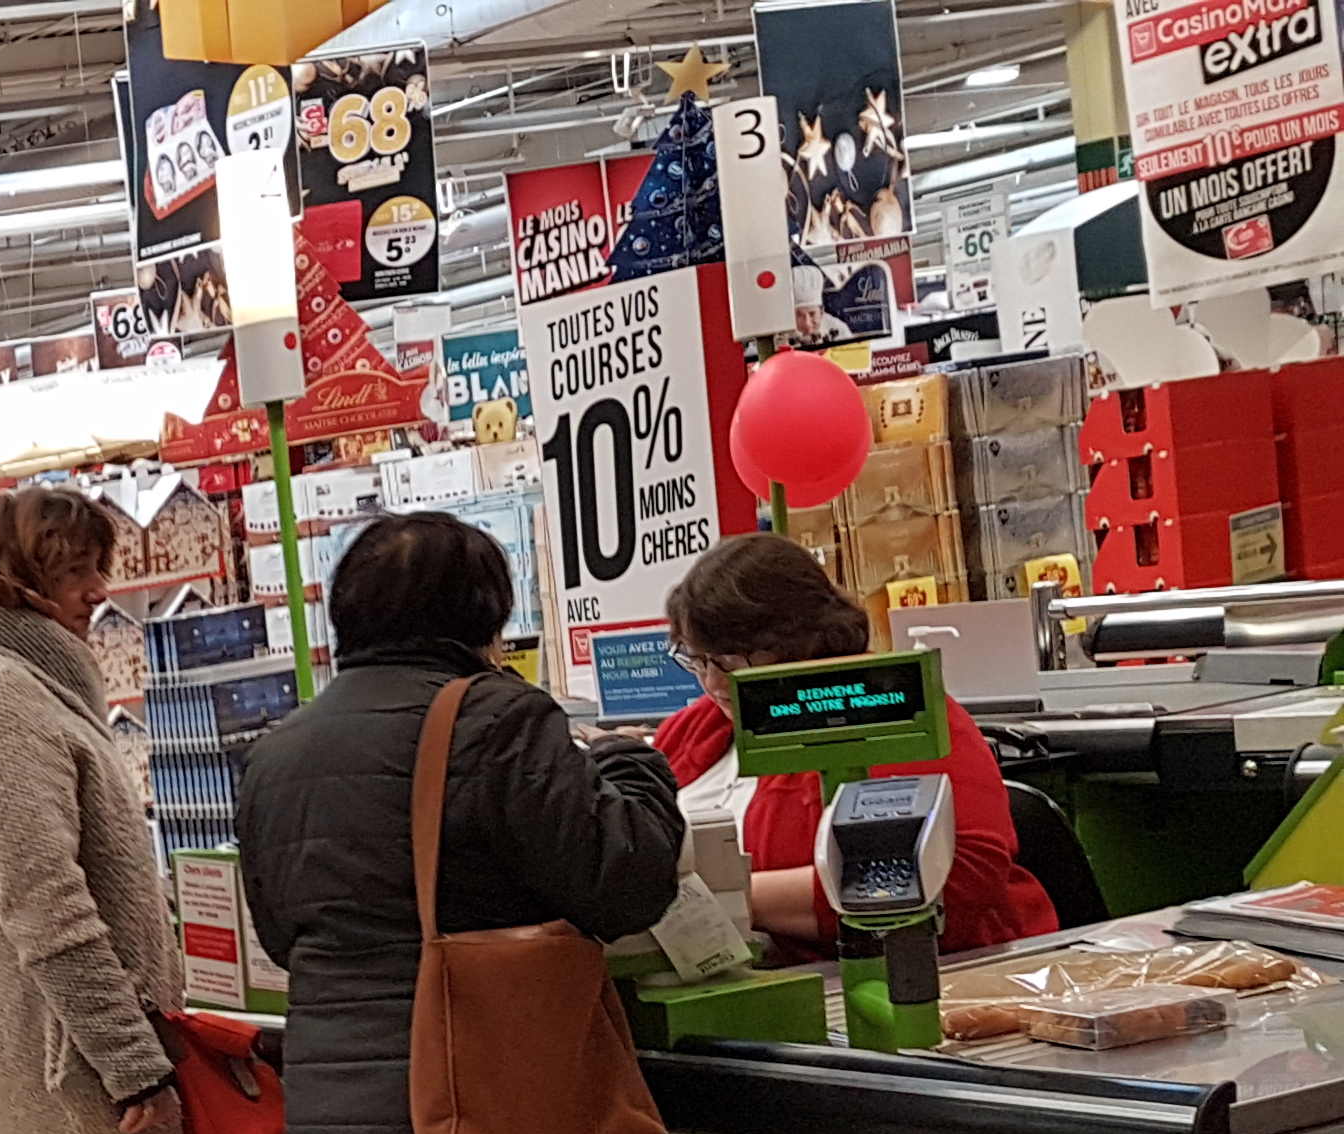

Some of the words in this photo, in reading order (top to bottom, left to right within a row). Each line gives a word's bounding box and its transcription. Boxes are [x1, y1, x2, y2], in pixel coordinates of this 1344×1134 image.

[1153, 105, 1174, 122] TOUT
[1178, 102, 1191, 116] LE
[1244, 80, 1270, 99] TOUS
[1273, 73, 1294, 91] LES
[1298, 63, 1330, 85] JOURS
[1197, 109, 1223, 128] AVEC
[1224, 100, 1261, 122] TOUTES
[1262, 95, 1281, 111] LES
[1282, 84, 1320, 107] OFFRES
[734, 108, 768, 160] 3
[1137, 144, 1204, 178] SEULEMENT
[1243, 121, 1280, 152] POUR
[1282, 116, 1302, 140] UN
[1303, 109, 1340, 135] MOIS
[1159, 184, 1188, 220] UN
[1190, 167, 1240, 211] MOIS
[1241, 141, 1314, 192] OFFERT
[519, 214, 534, 239] LE
[540, 200, 580, 231] MOIS
[616, 201, 633, 224] LE
[517, 215, 606, 270] CASINO
[520, 247, 610, 303] MANIA
[547, 302, 614, 353] TOUTES
[621, 285, 659, 327] VOS
[550, 324, 663, 402] COURSES
[870, 351, 912, 366] ÉCOUVREZ
[315, 382, 375, 410] Lindt
[541, 376, 684, 590] 10%
[639, 473, 696, 521] MOINS
[640, 517, 711, 566] CHÈRES
[567, 596, 601, 623] AVEC
[600, 659, 616, 669] AU
[629, 640, 656, 653] AVEZ
[769, 702, 802, 719] DANS
[807, 697, 847, 714] VOTRE
[849, 692, 905, 710] MAGASIN
[797, 682, 866, 702] BIENVENUE
